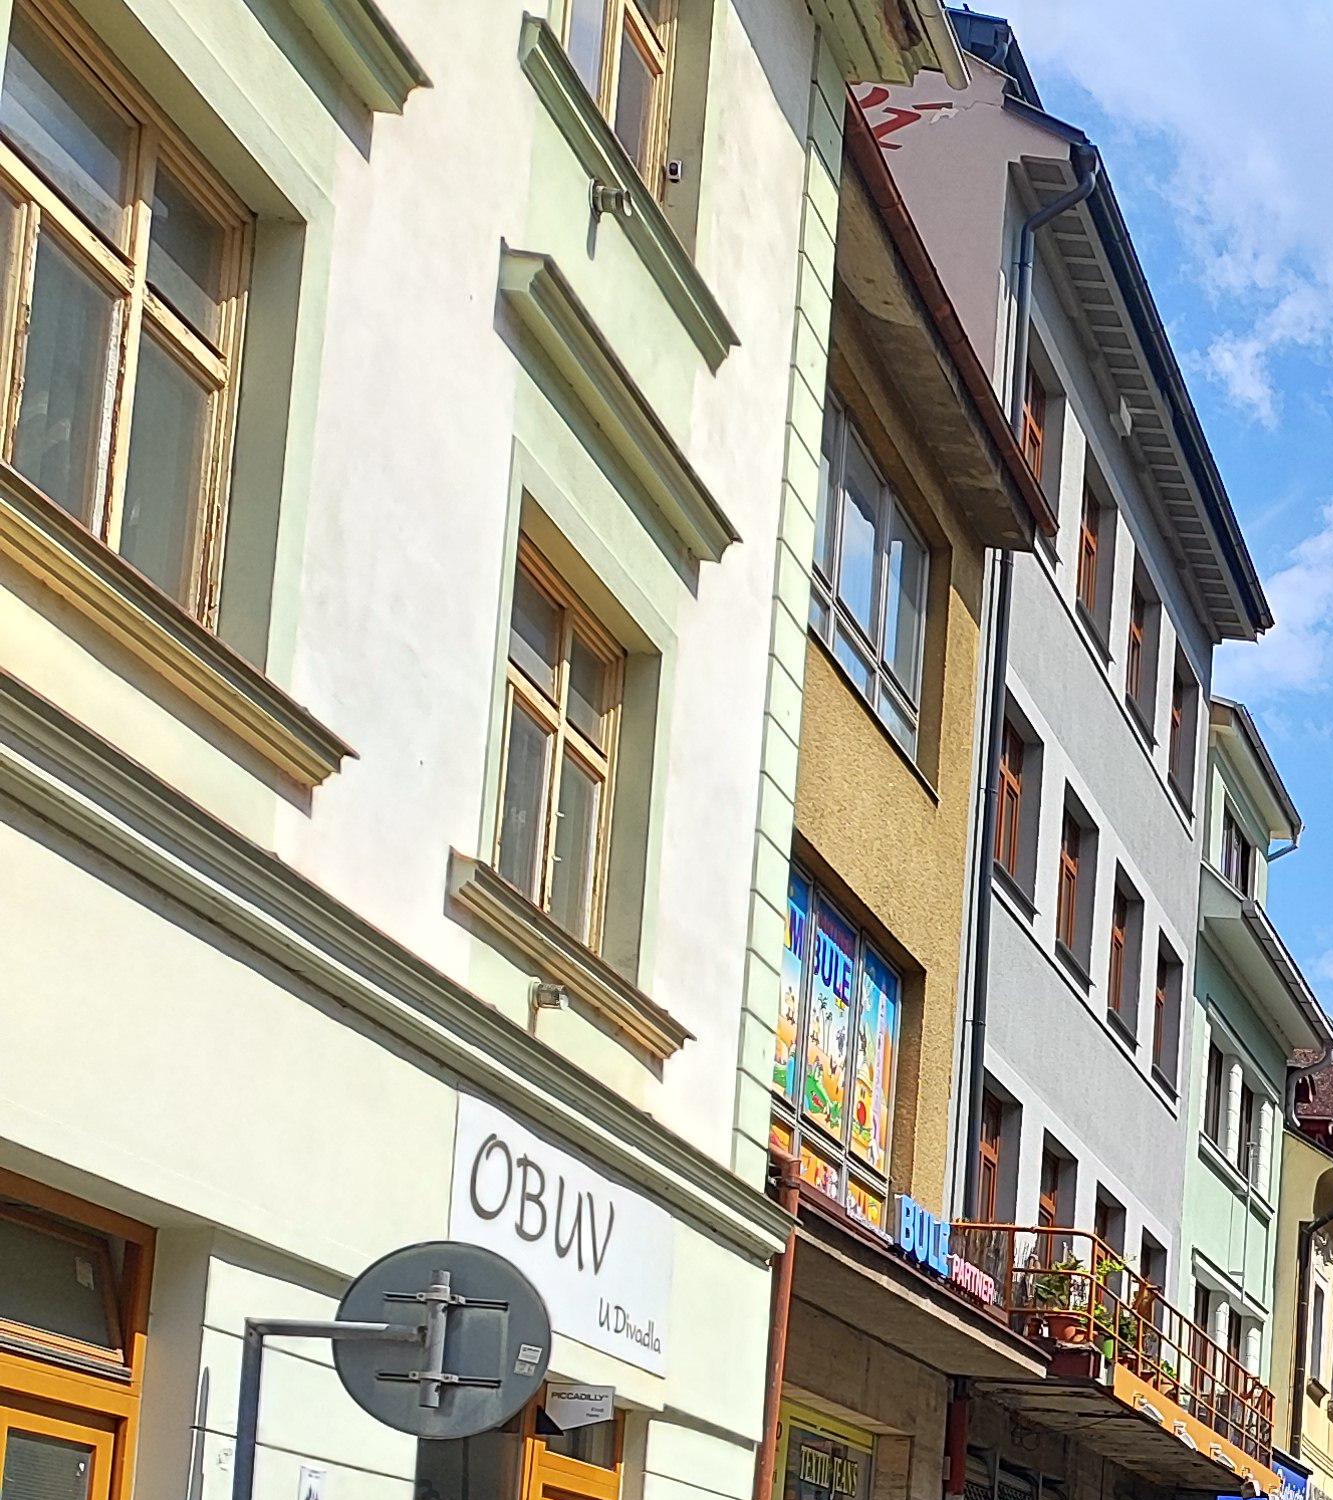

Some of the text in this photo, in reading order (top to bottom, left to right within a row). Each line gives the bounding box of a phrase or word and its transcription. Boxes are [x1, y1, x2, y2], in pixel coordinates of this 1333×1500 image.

[469, 1132, 615, 1276] OBUV
[951, 1253, 995, 1306] PARTNER
[598, 1296, 662, 1355] U Divadla
[551, 1391, 606, 1401] PICCADILLY
